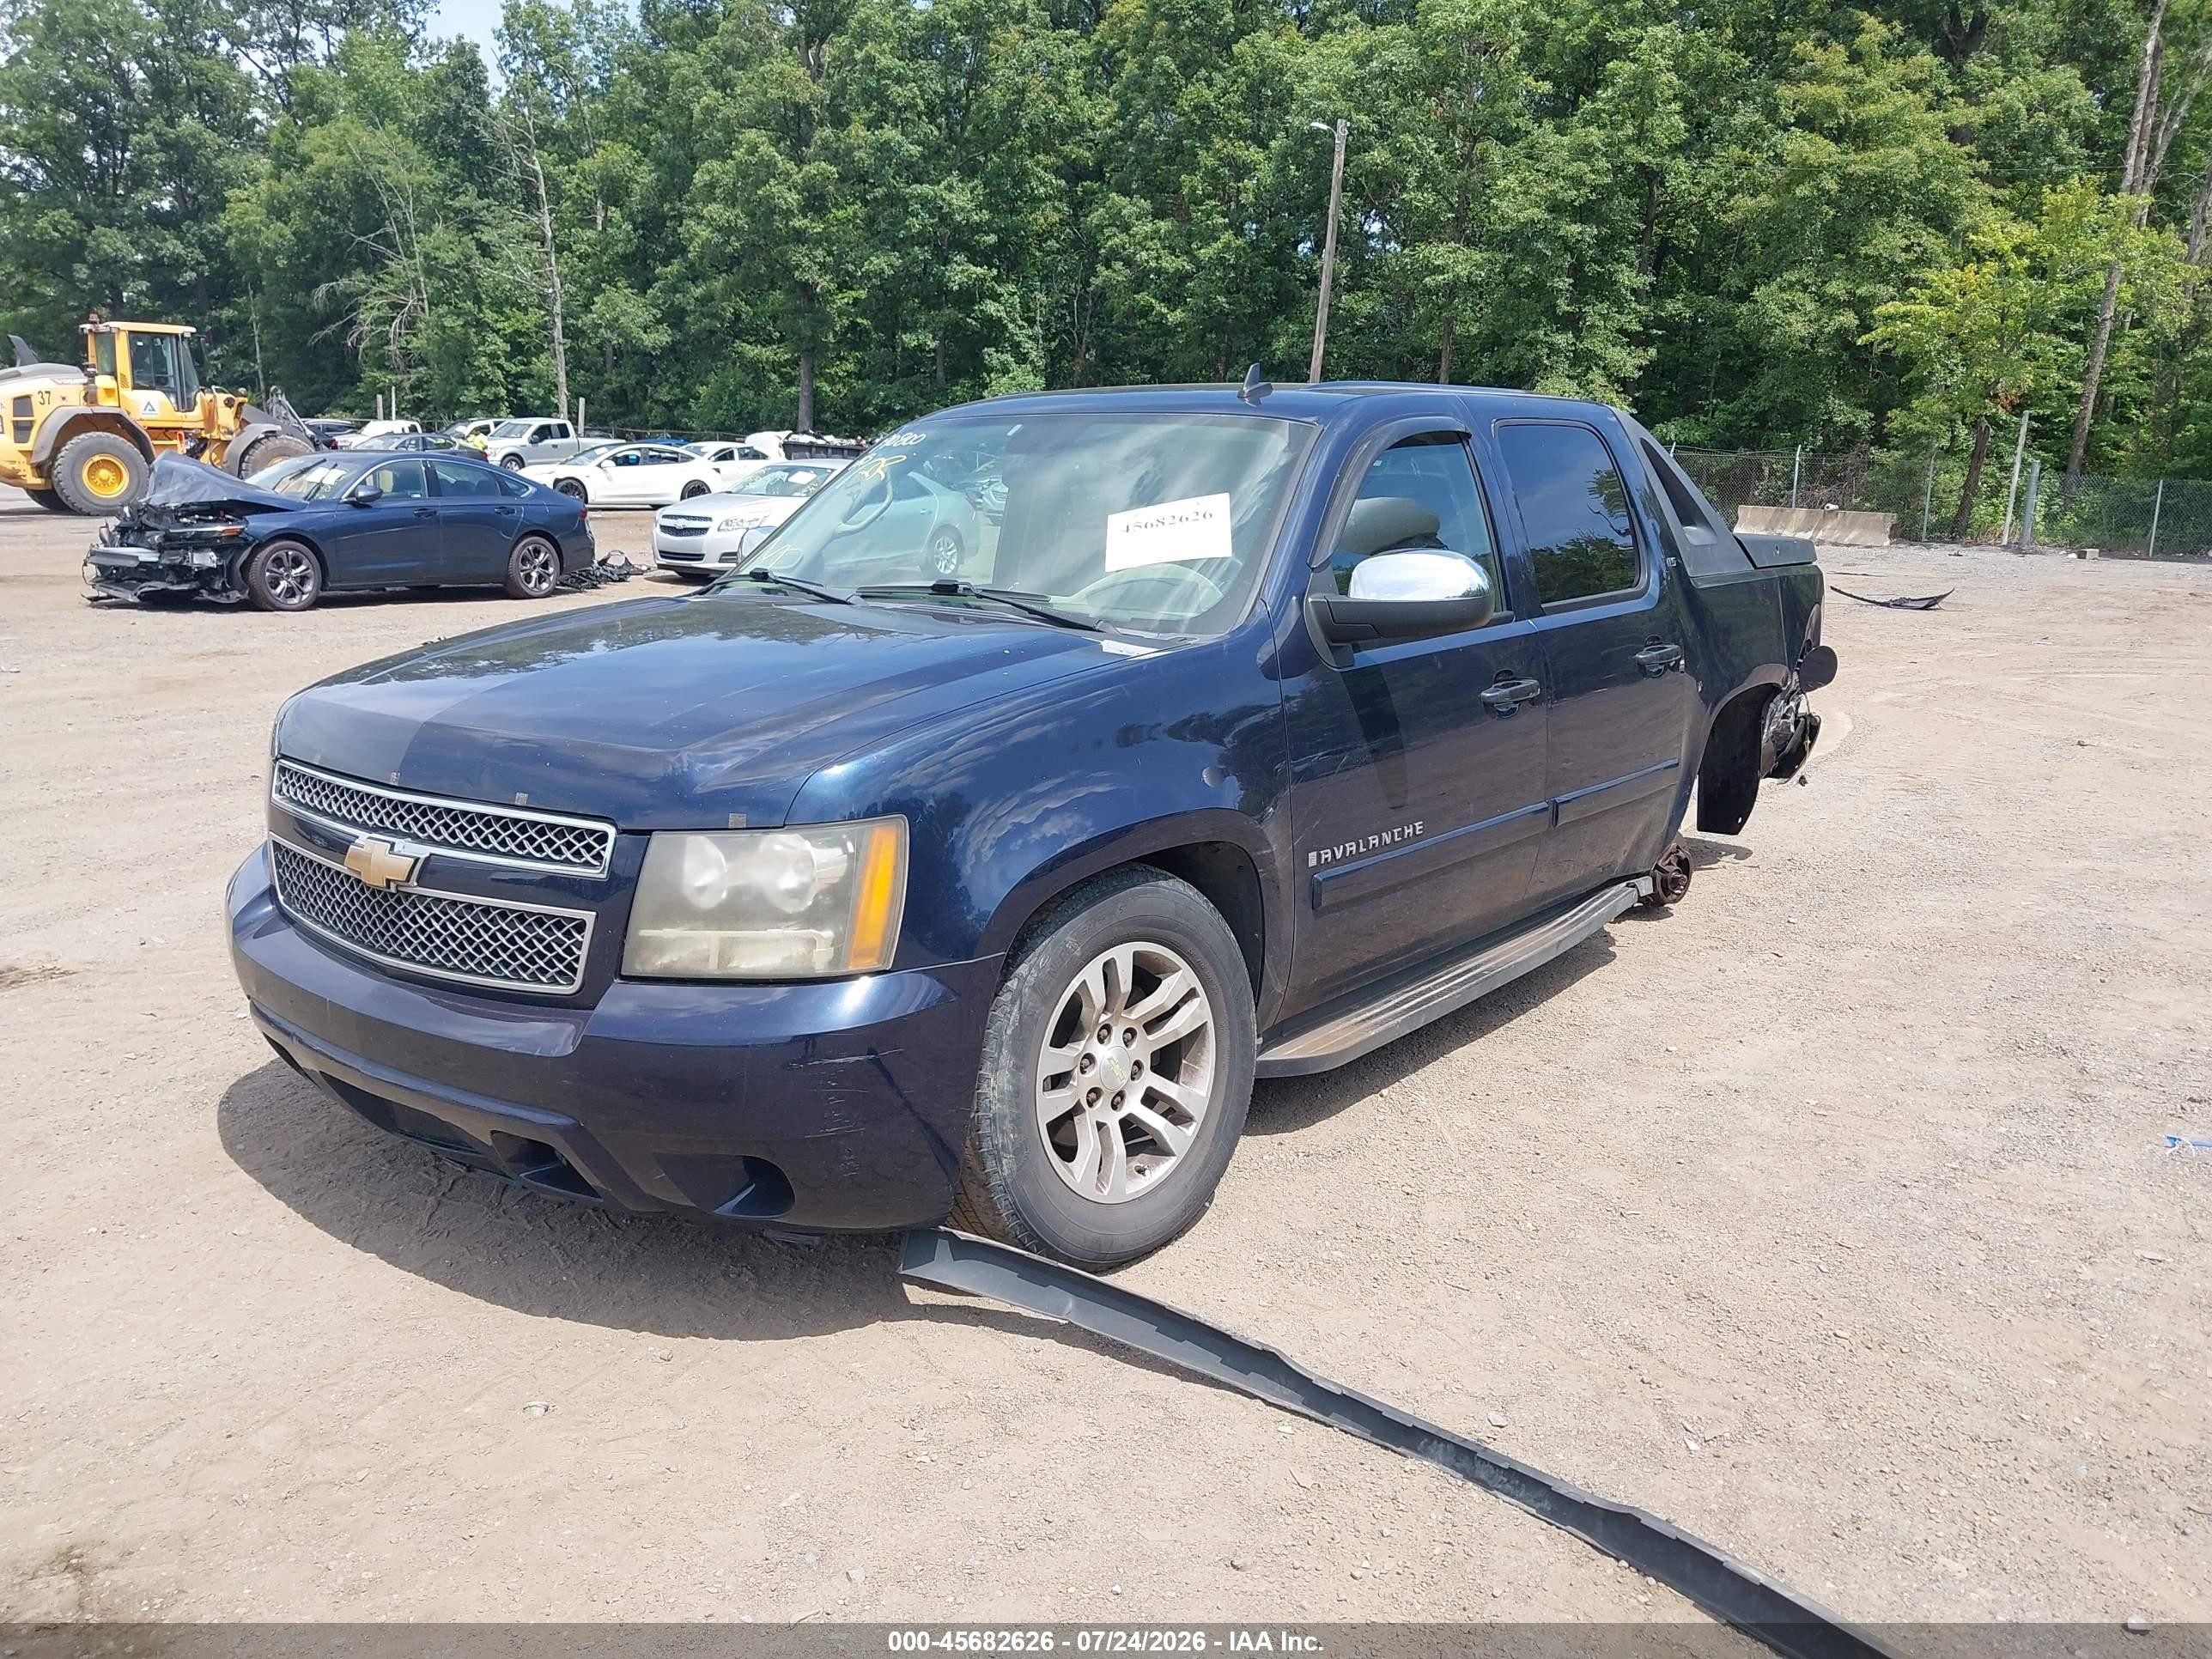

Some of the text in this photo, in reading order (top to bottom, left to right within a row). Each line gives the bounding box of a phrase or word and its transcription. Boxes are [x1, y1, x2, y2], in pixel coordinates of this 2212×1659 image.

[37, 390, 52, 405] 37
[1120, 509, 1213, 534] 45682626
[1320, 820, 1424, 865] AVALANCHE
